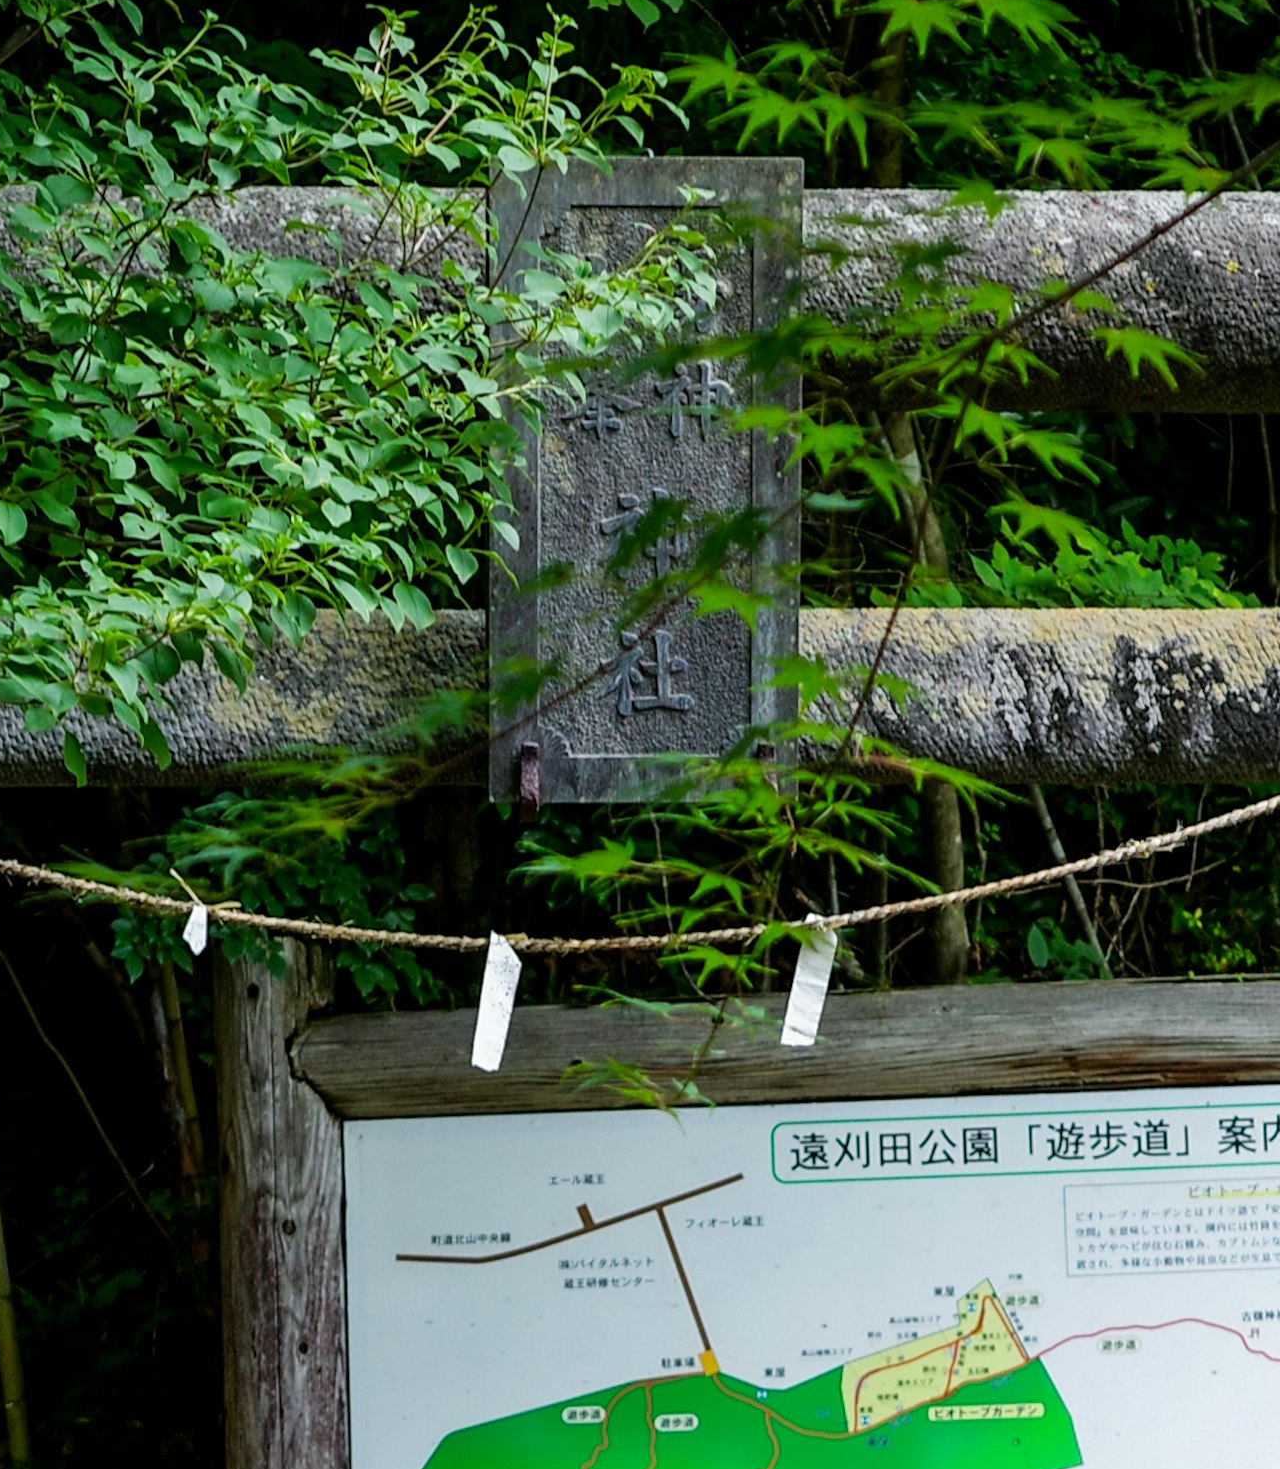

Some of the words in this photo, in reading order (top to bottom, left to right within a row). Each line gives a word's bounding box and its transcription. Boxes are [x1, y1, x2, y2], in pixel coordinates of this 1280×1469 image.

[549, 1173, 605, 1186] エール蔵王
[685, 1215, 765, 1229] フィオーレ蔵王
[1006, 1295, 1040, 1307] 遊歩道
[1102, 1338, 1137, 1351] 遊歩道
[661, 1356, 695, 1369] 駐車場
[567, 1408, 602, 1421] 遊歩道
[935, 1406, 1038, 1420] ビオトープガーデン
[660, 1416, 695, 1429] 遊歩道
